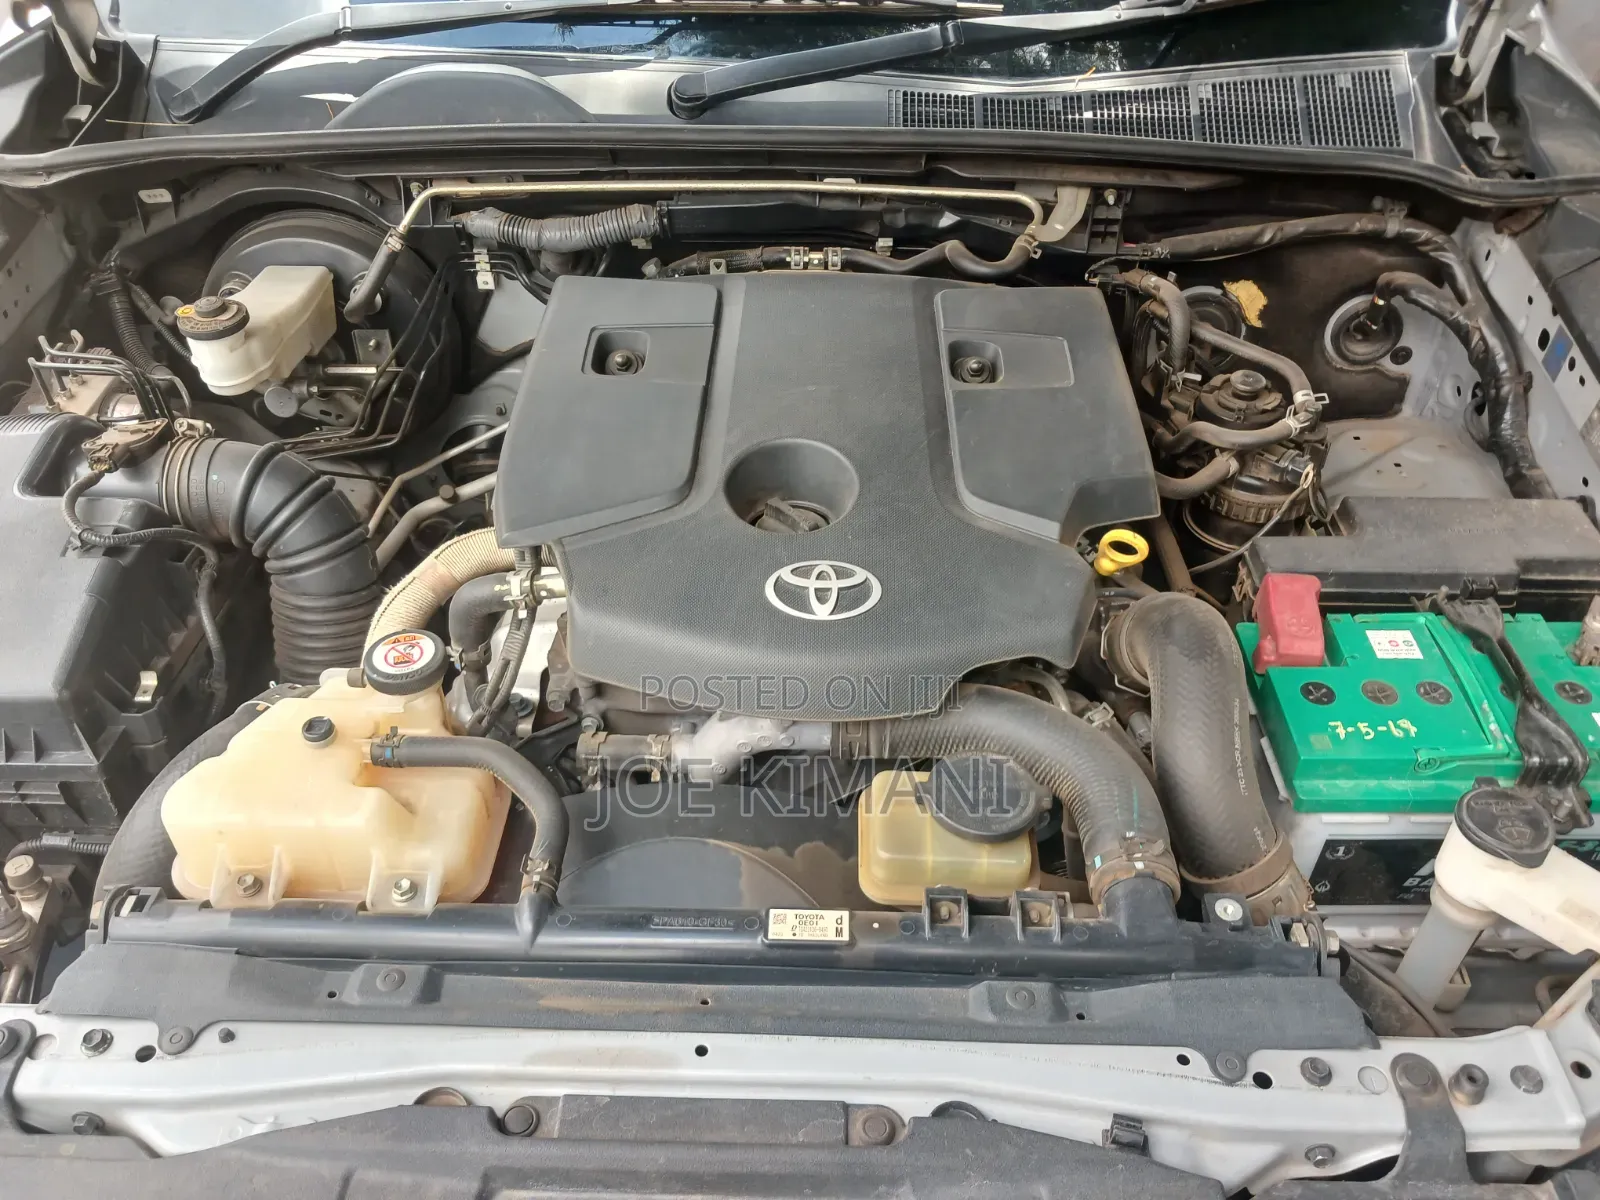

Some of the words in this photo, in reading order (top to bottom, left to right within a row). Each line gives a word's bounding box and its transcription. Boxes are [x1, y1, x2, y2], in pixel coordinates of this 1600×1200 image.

[794, 913, 825, 921] TOYOTA
[835, 914, 843, 926] d
[835, 926, 844, 938] M
